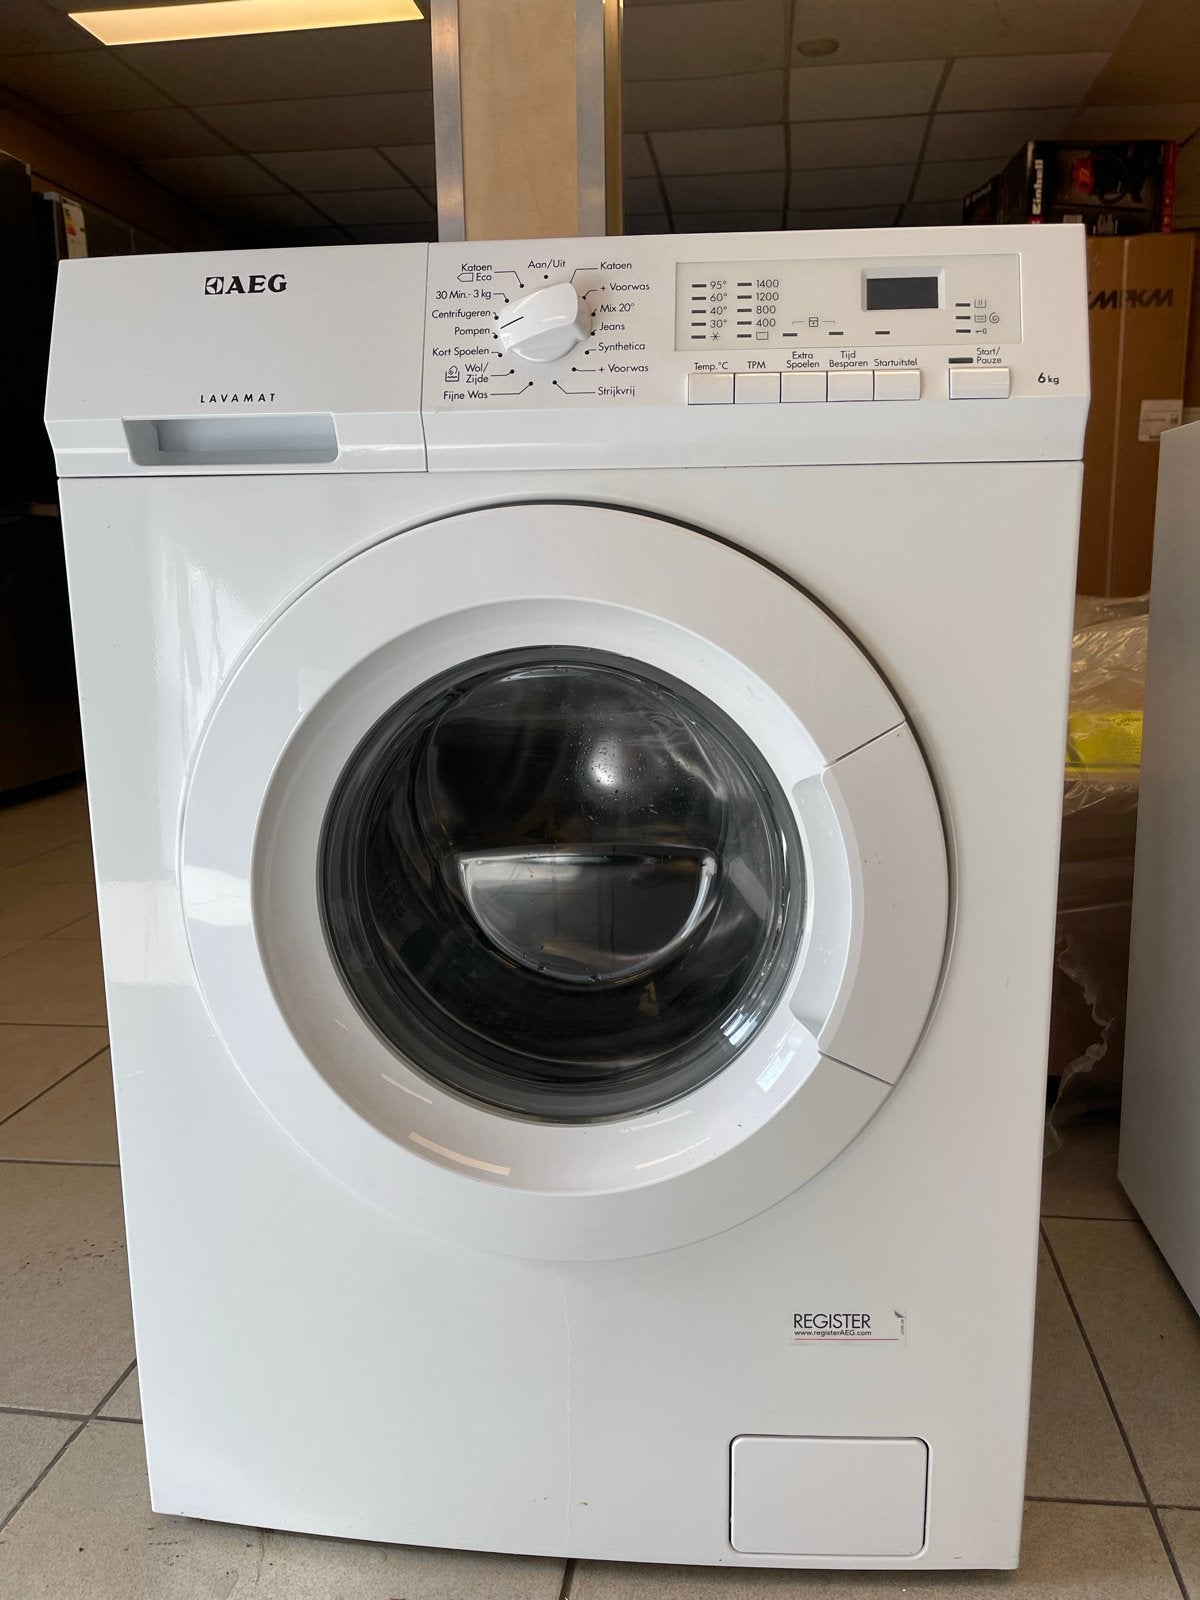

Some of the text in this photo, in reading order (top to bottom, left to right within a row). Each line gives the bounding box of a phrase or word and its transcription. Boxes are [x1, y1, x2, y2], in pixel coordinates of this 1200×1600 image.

[461, 263, 492, 272] Katoen
[528, 259, 566, 269] Aan/Uit
[600, 262, 632, 270] Katoen
[476, 273, 492, 281] Eco
[225, 274, 287, 294] AEG
[610, 282, 650, 291] Voorwas
[710, 280, 726, 290] 95°
[756, 279, 780, 288] 1400
[436, 290, 448, 300] 30
[474, 290, 480, 298] 3
[481, 289, 492, 300] kg
[710, 292, 728, 302] 60°
[756, 292, 780, 301] 1200
[600, 302, 634, 312] Mix 20°
[710, 306, 728, 315] 40°
[756, 305, 776, 314] 800
[432, 308, 491, 320] Centrifugeren
[599, 322, 626, 331] Jeans
[710, 319, 728, 328] 30°
[756, 318, 776, 328] 400
[454, 326, 490, 337] Pompen
[432, 346, 490, 358] Kort Spoelen
[598, 342, 646, 354] Synthetica
[976, 346, 1000, 356] Start/
[792, 351, 814, 360] Extra
[840, 350, 856, 360] Tijd
[976, 356, 1002, 364] Pauze
[747, 360, 766, 369] TPM
[786, 360, 820, 370] Spoelen
[829, 359, 868, 368] Besparen
[874, 358, 918, 366] Startuitstel
[465, 362, 489, 373] Wol/
[608, 364, 649, 373] Voorwas
[466, 374, 489, 385] Zijde
[1038, 372, 1060, 385] 6 kg
[444, 390, 488, 402] Fijne Was
[598, 386, 636, 397] Strijkvrij
[200, 394, 276, 403] LAVAMAT
[794, 1314, 871, 1328] REGISTER
